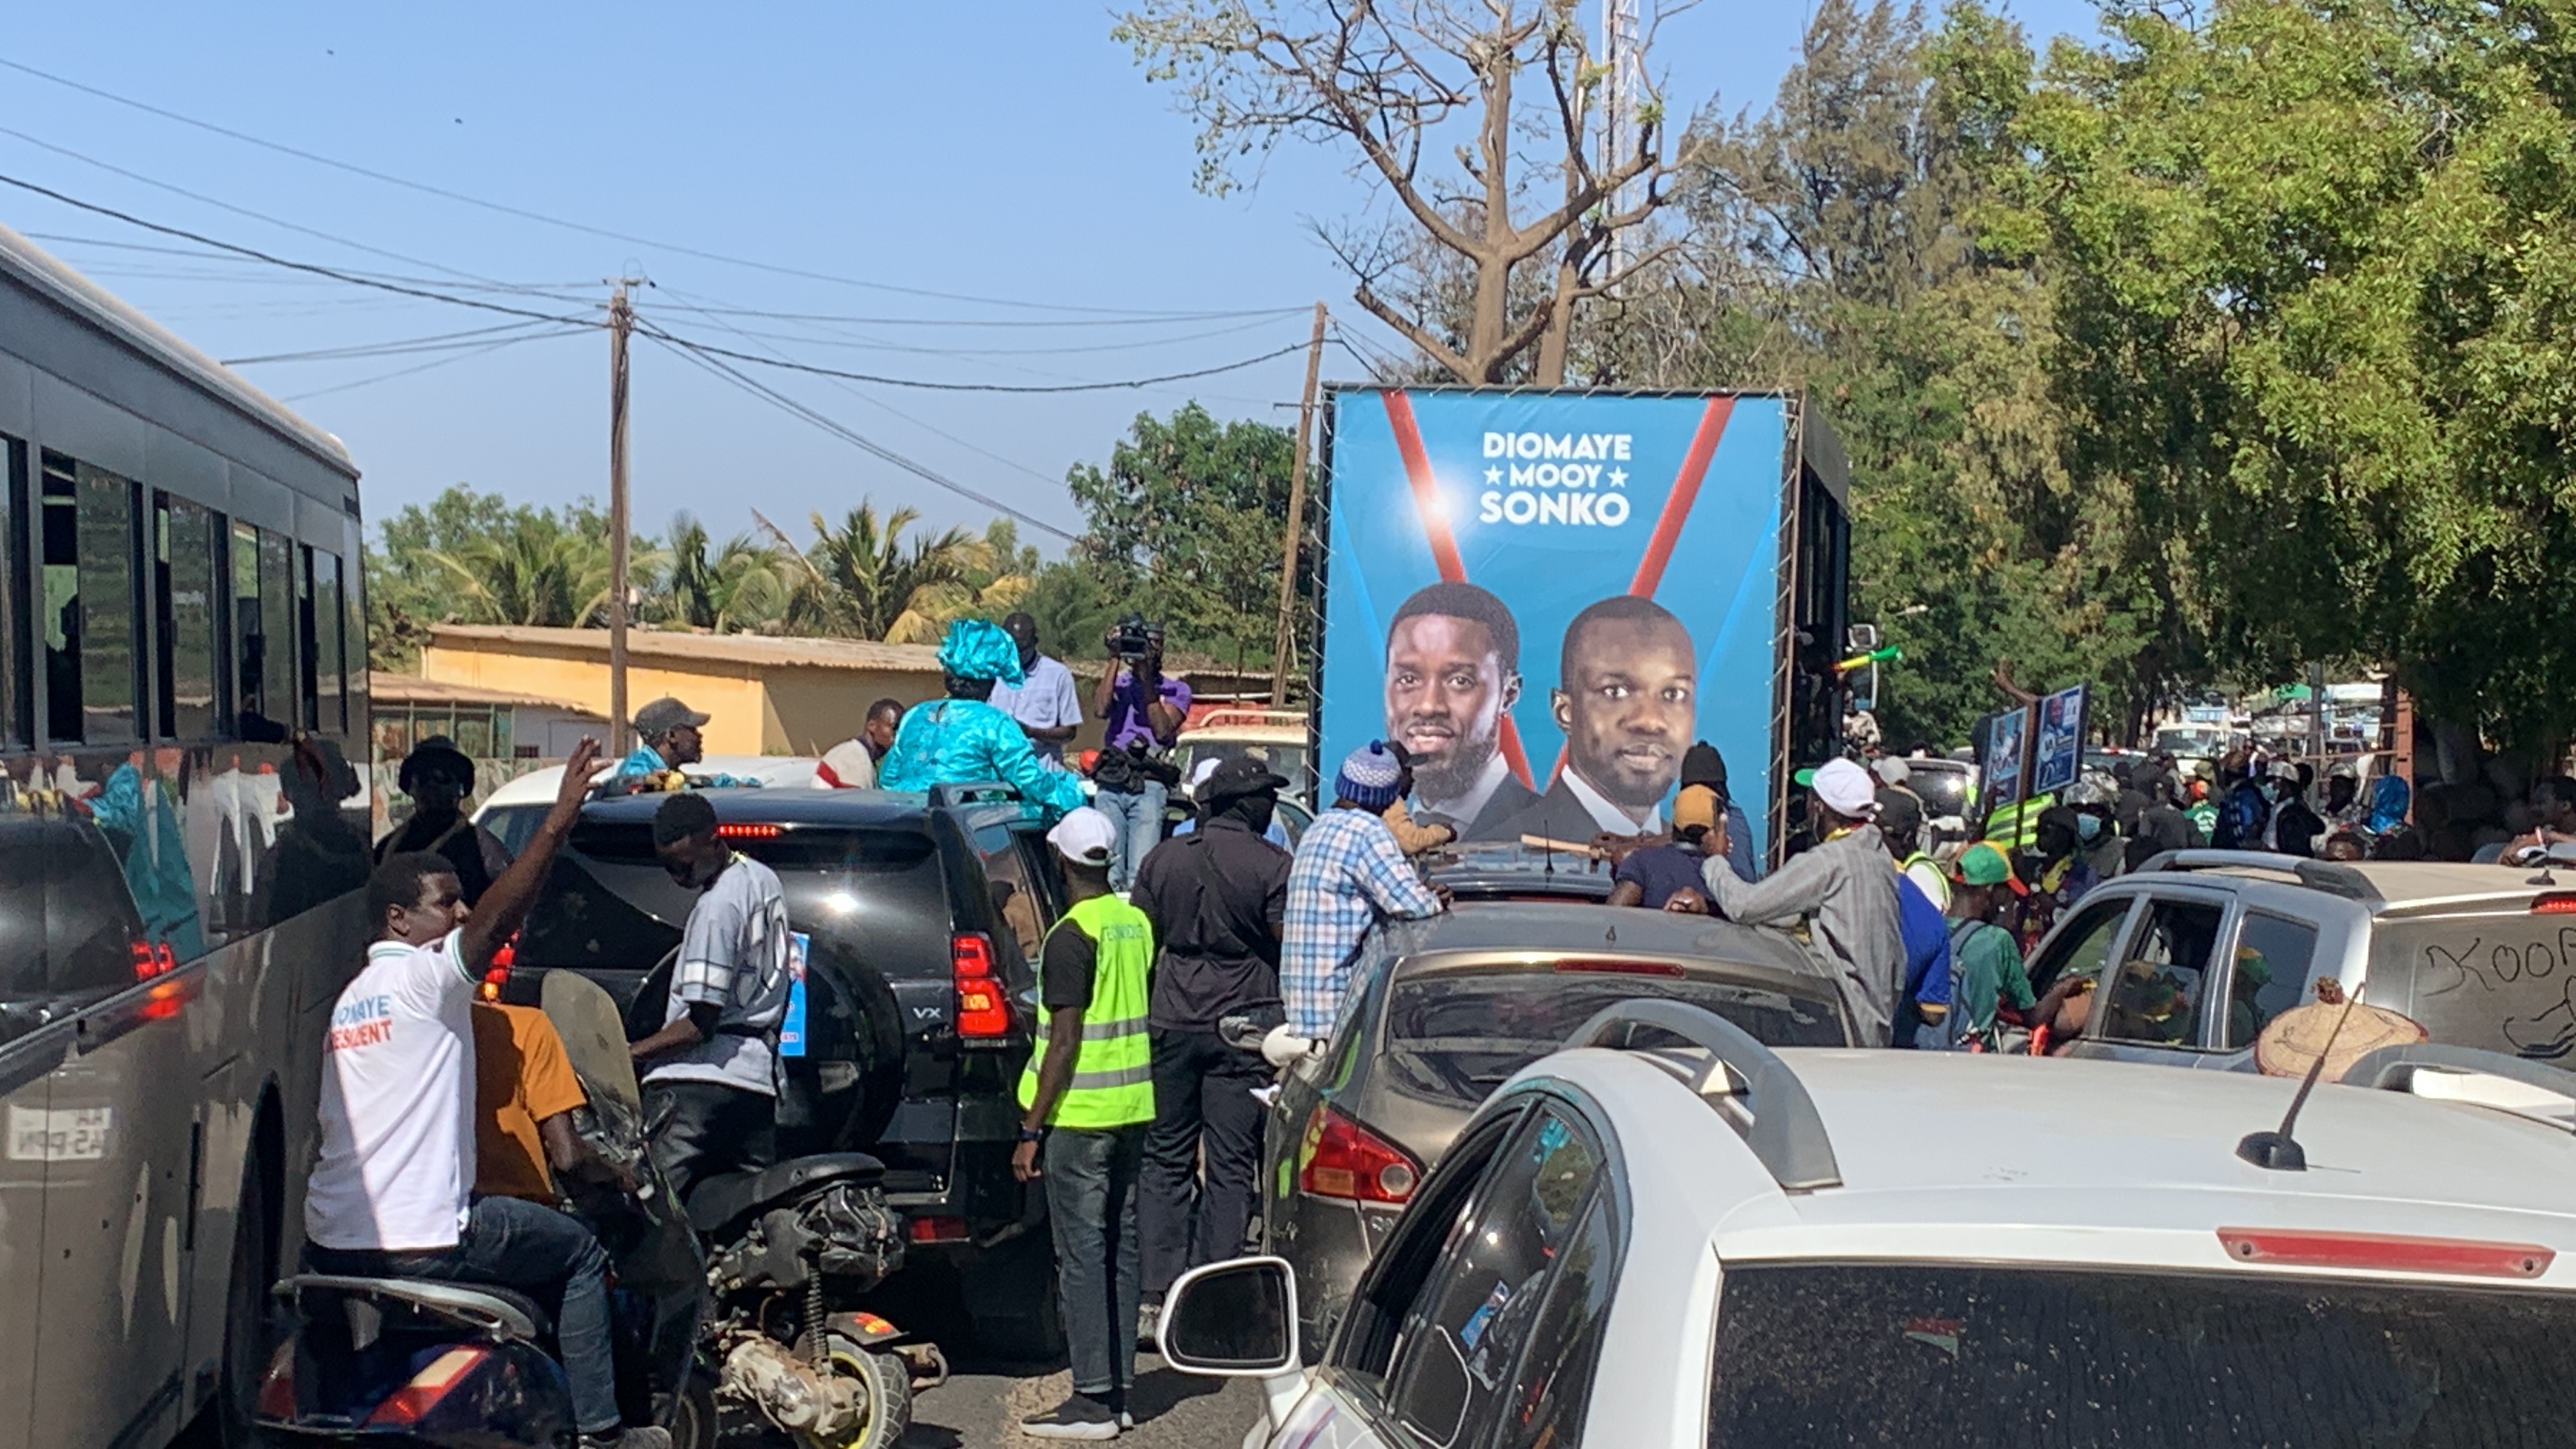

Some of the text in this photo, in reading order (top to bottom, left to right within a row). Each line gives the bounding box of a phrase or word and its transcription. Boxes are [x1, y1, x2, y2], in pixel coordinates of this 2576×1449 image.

[1483, 431, 1633, 460] DIOMAYE
[1509, 462, 1603, 489] MOOY
[1479, 490, 1631, 527] SONKO
[913, 1007, 942, 1019] VX
